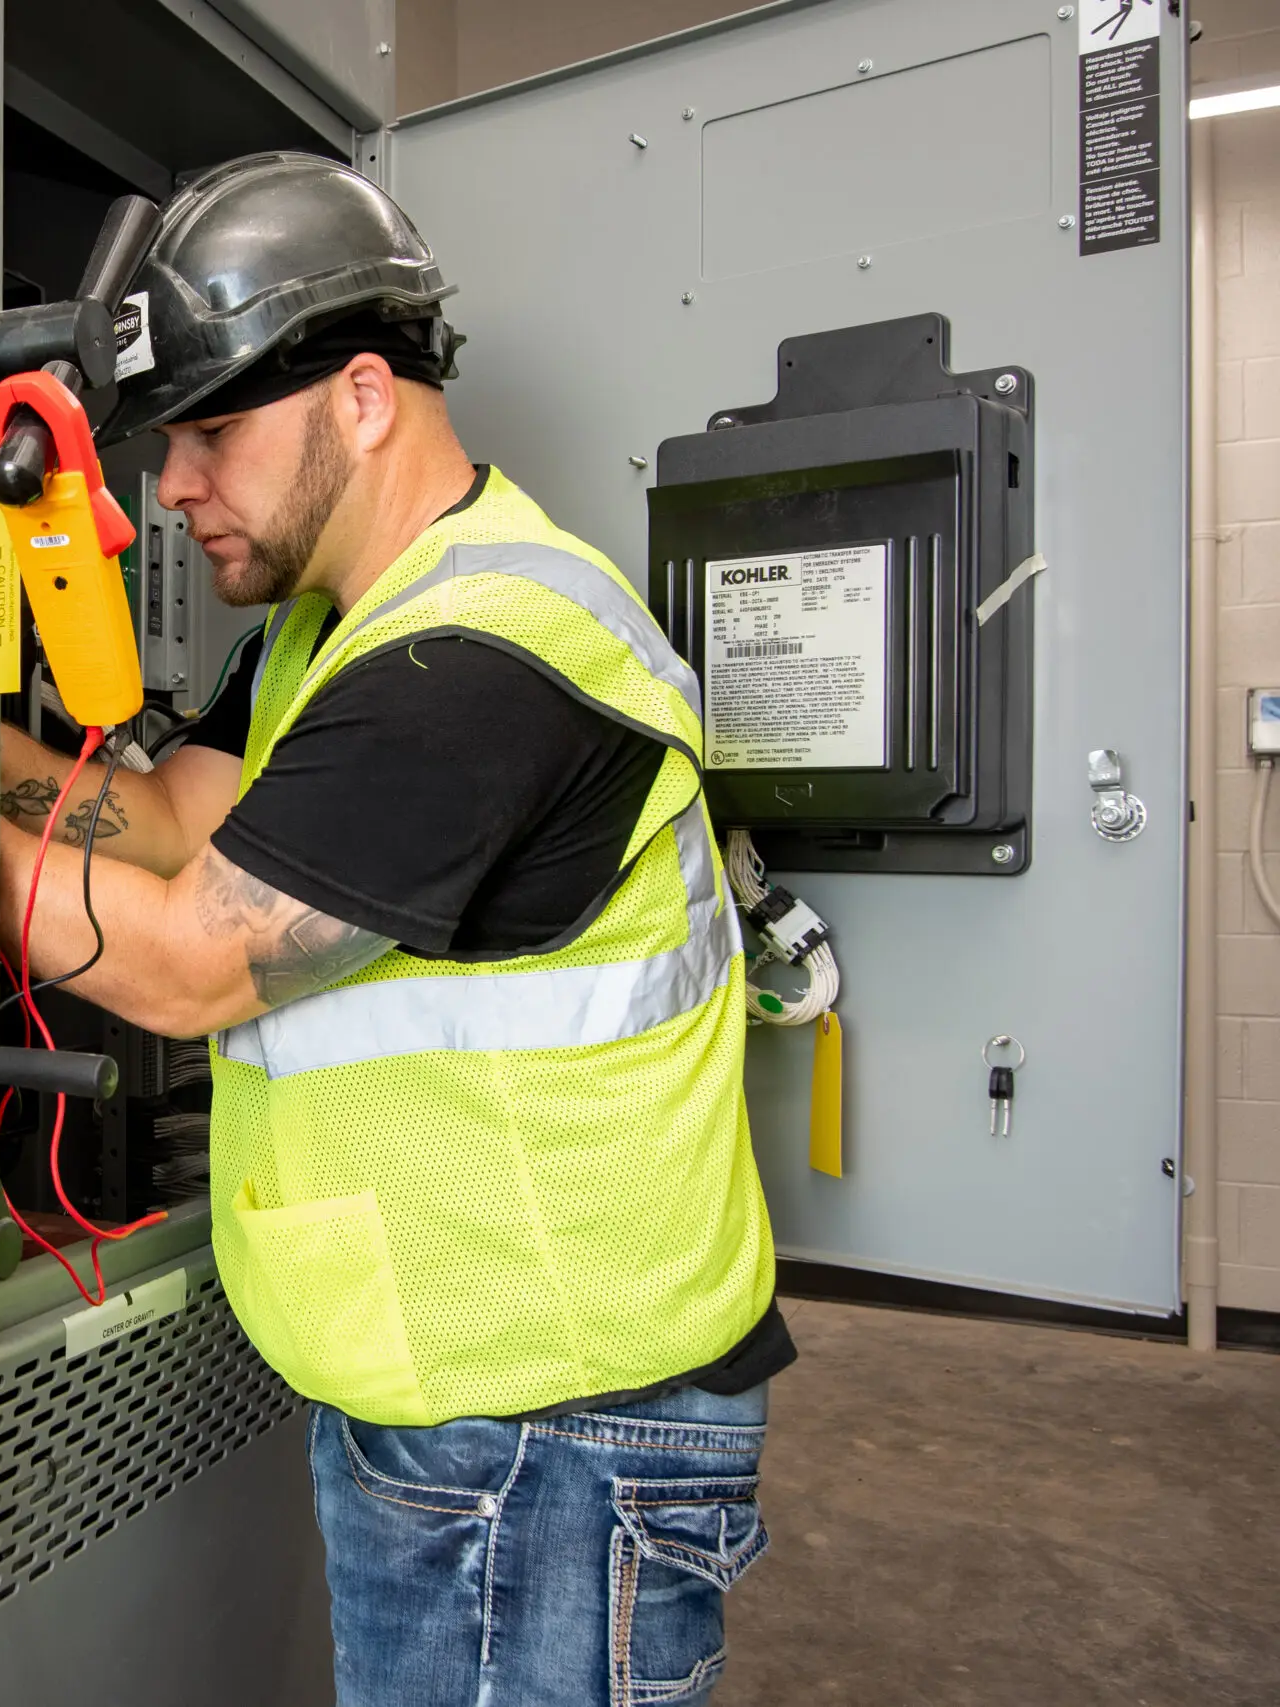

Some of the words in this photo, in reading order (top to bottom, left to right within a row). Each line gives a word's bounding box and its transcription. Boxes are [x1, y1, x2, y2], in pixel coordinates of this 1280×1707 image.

[721, 564, 788, 585] KOHLER
[102, 1323, 124, 1339] CENTER
[125, 1318, 133, 1328] OF
[133, 1310, 155, 1324] GRAVITY
